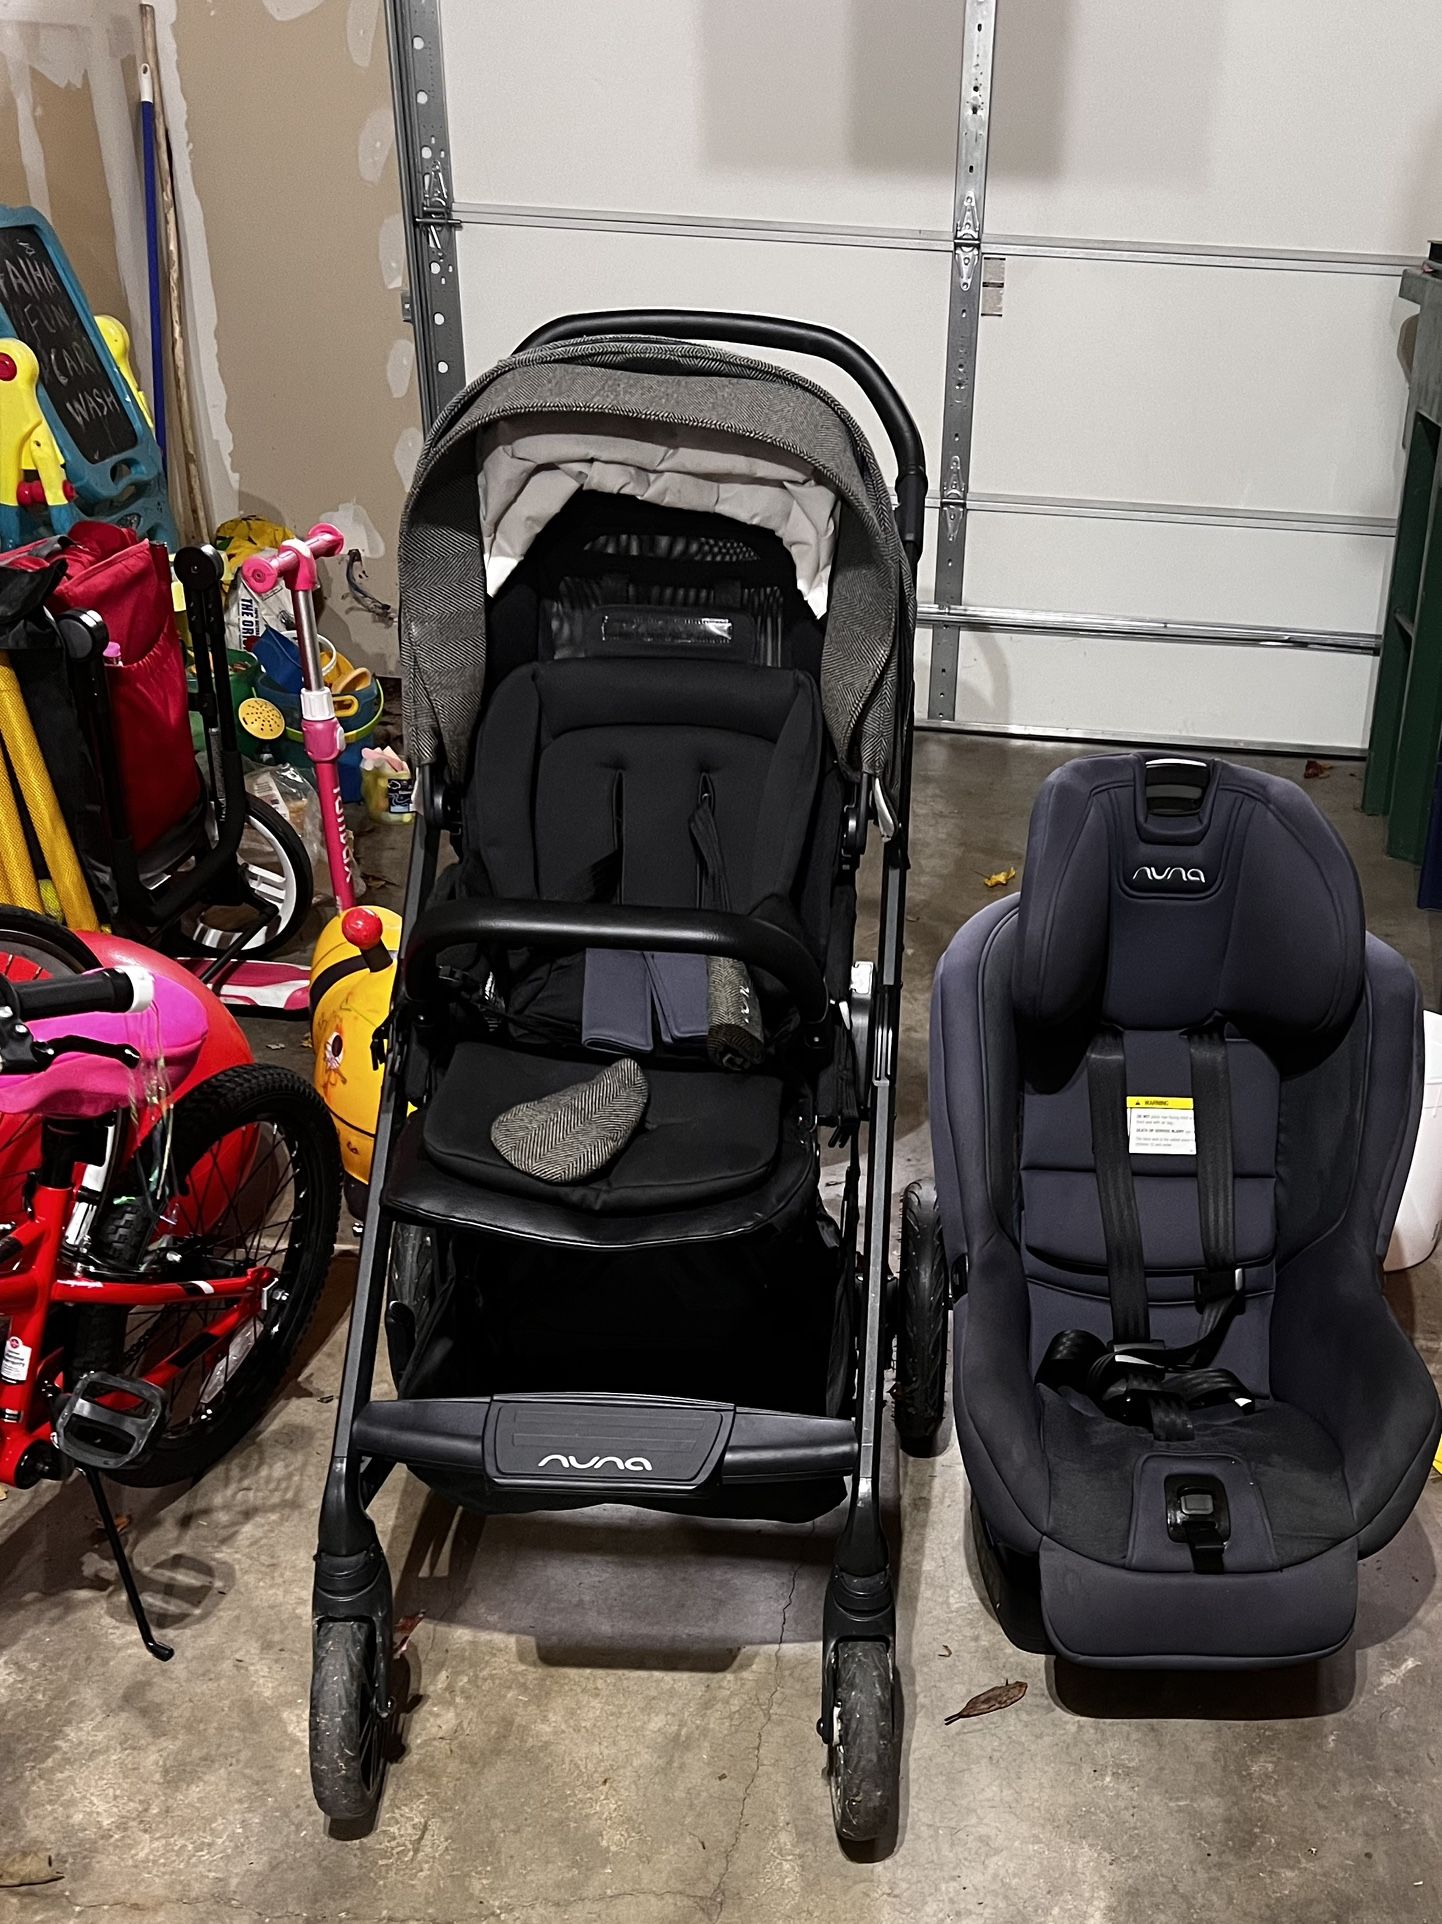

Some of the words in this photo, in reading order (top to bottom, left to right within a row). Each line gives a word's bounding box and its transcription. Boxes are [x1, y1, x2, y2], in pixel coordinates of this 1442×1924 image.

[50, 341, 97, 386] CAR
[65, 388, 121, 430] WASH
[241, 598, 253, 617] THE
[1132, 866, 1206, 883] nuna
[538, 1454, 653, 1471] nuna
